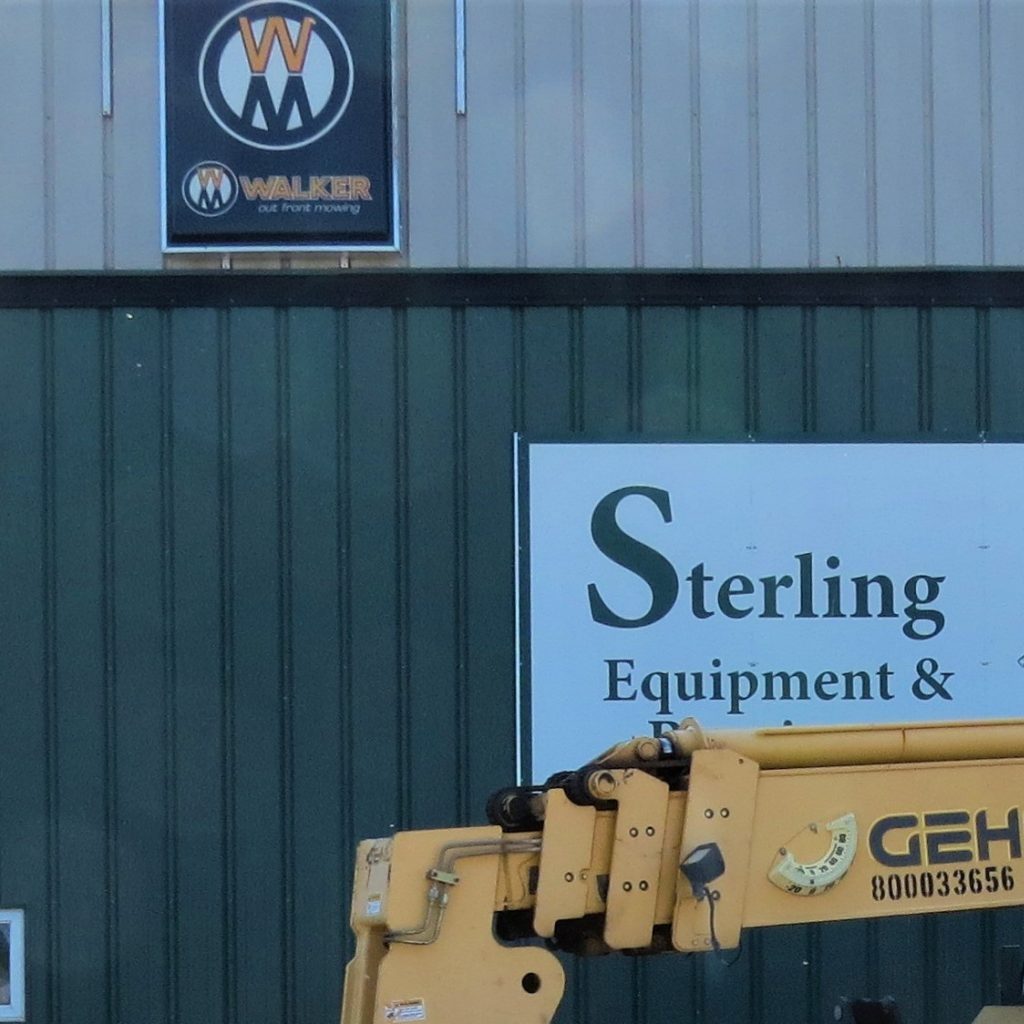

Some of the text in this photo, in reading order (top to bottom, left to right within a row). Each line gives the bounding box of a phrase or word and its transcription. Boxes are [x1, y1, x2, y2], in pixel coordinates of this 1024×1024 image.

[239, 175, 372, 200] WALKER
[258, 202, 361, 216] out front mowing
[588, 486, 945, 640] Sterling
[604, 658, 954, 714] Equipment &
[871, 865, 1015, 901] 800033656
